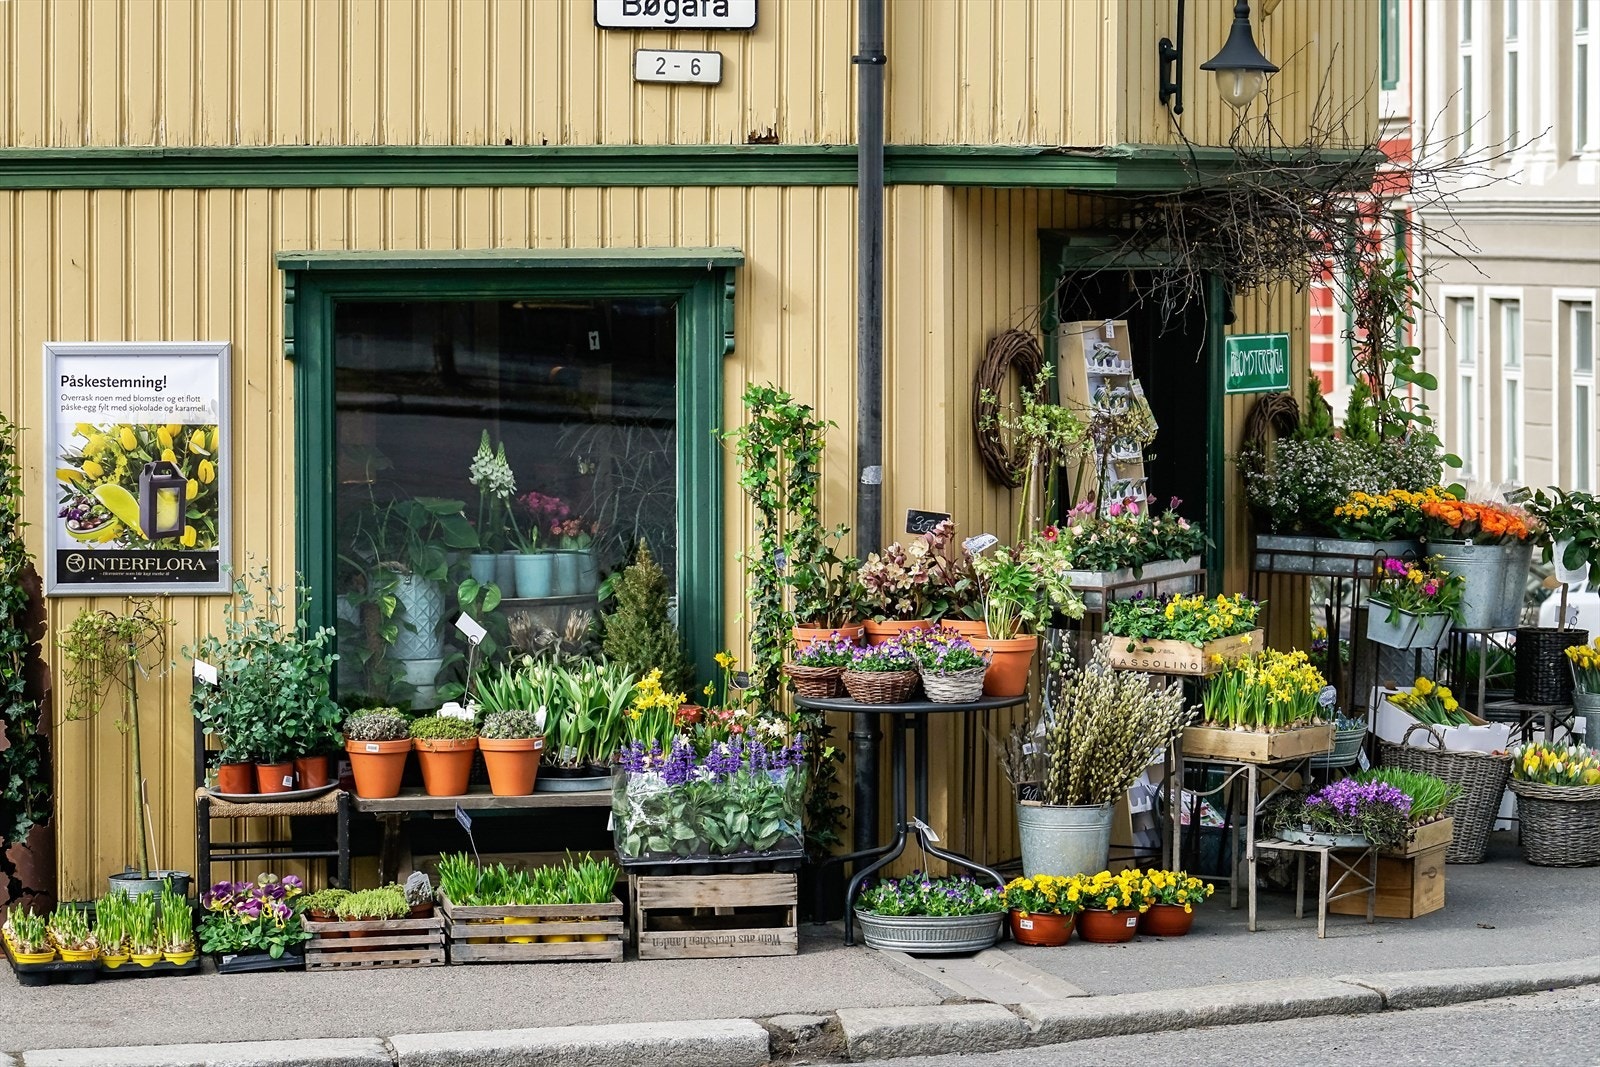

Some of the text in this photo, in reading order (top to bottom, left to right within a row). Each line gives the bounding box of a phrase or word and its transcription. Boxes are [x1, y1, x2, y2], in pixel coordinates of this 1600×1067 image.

[655, 57, 666, 75] 2
[690, 58, 701, 76] 6
[60, 375, 167, 391] Påskestemning!
[60, 393, 94, 402] Overrask
[115, 394, 131, 402] med
[133, 394, 165, 402] blomster
[166, 396, 176, 404] og
[186, 394, 201, 402] flott
[60, 403, 97, 413] påske-egg
[98, 403, 109, 413] fylt
[111, 403, 127, 411] med
[129, 403, 163, 413] sjokolade
[175, 404, 208, 412] karamell.
[88, 557, 207, 571] INTERFLORA
[1108, 658, 1198, 669] MASSOLINO
[688, 934, 736, 949] deutschen
[738, 934, 756, 944] aus
[758, 933, 782, 946] Wein
